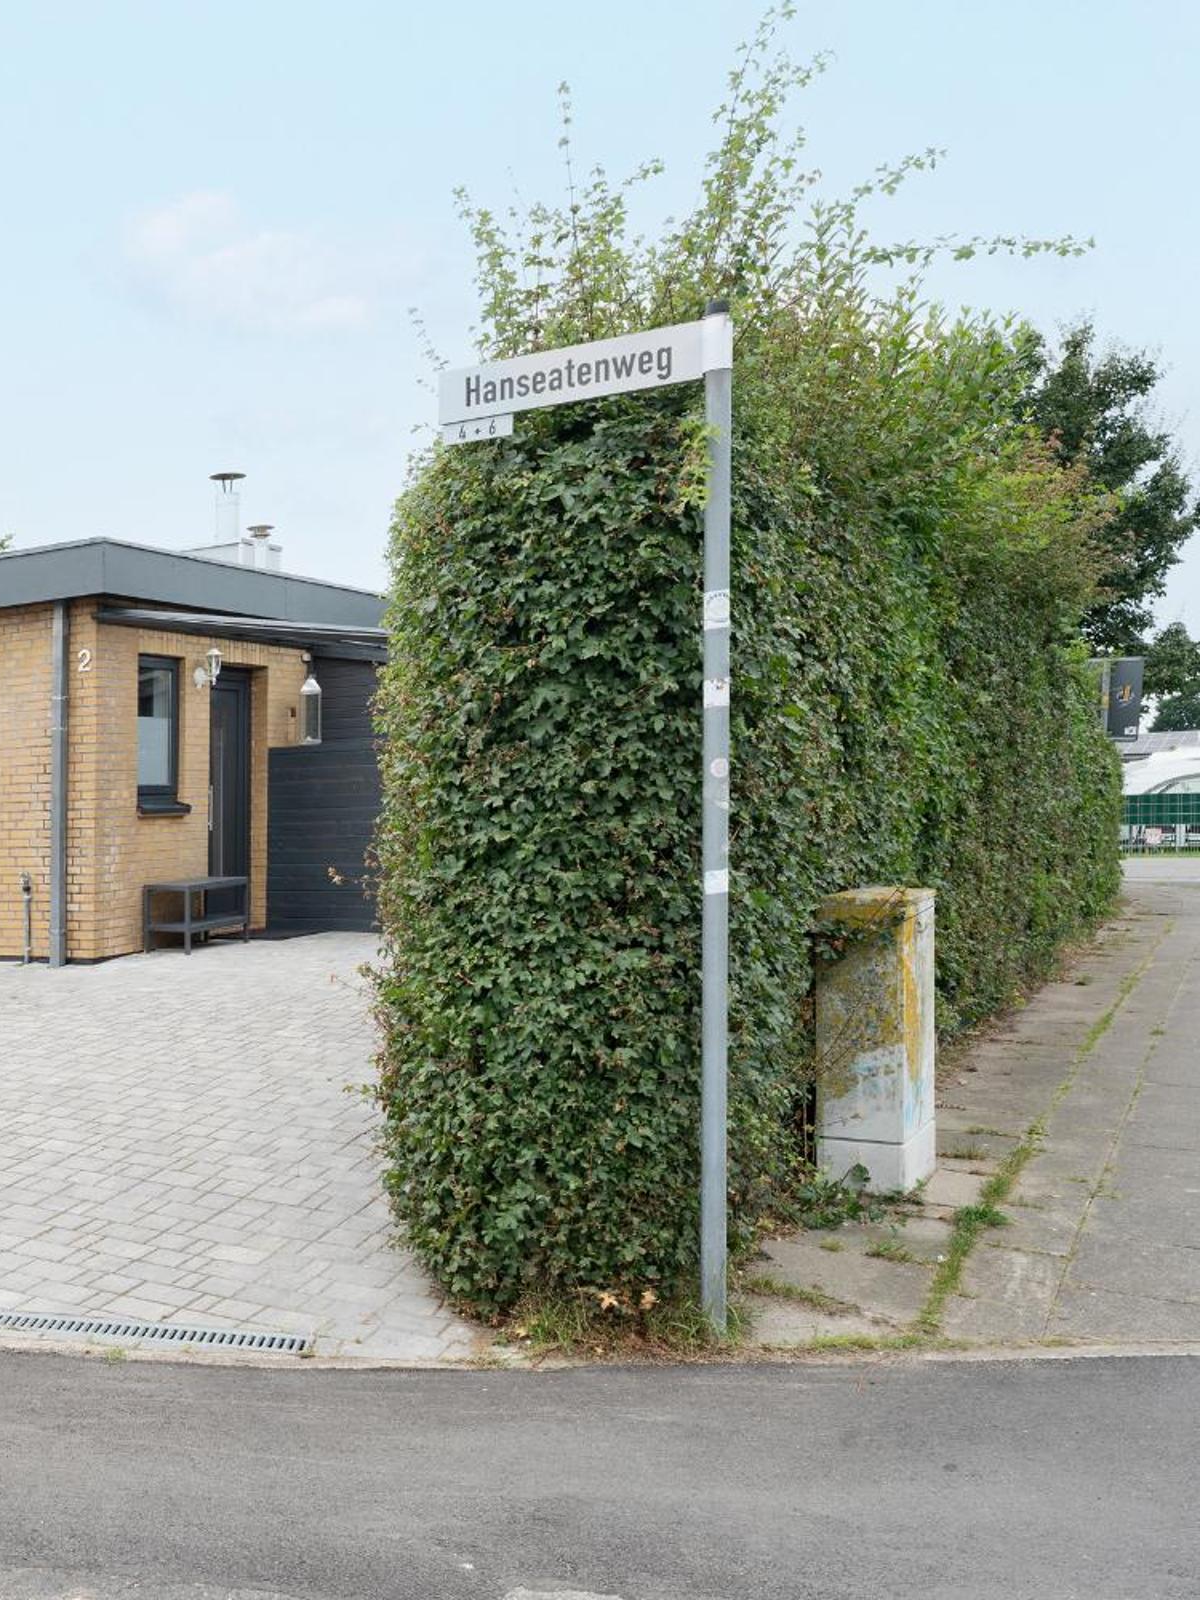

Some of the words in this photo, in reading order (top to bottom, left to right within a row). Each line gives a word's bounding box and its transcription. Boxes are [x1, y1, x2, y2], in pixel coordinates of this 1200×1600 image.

[464, 345, 673, 407] Hanseatenweg
[458, 424, 467, 439] 4
[488, 419, 497, 436] 6
[78, 649, 91, 672] 2
